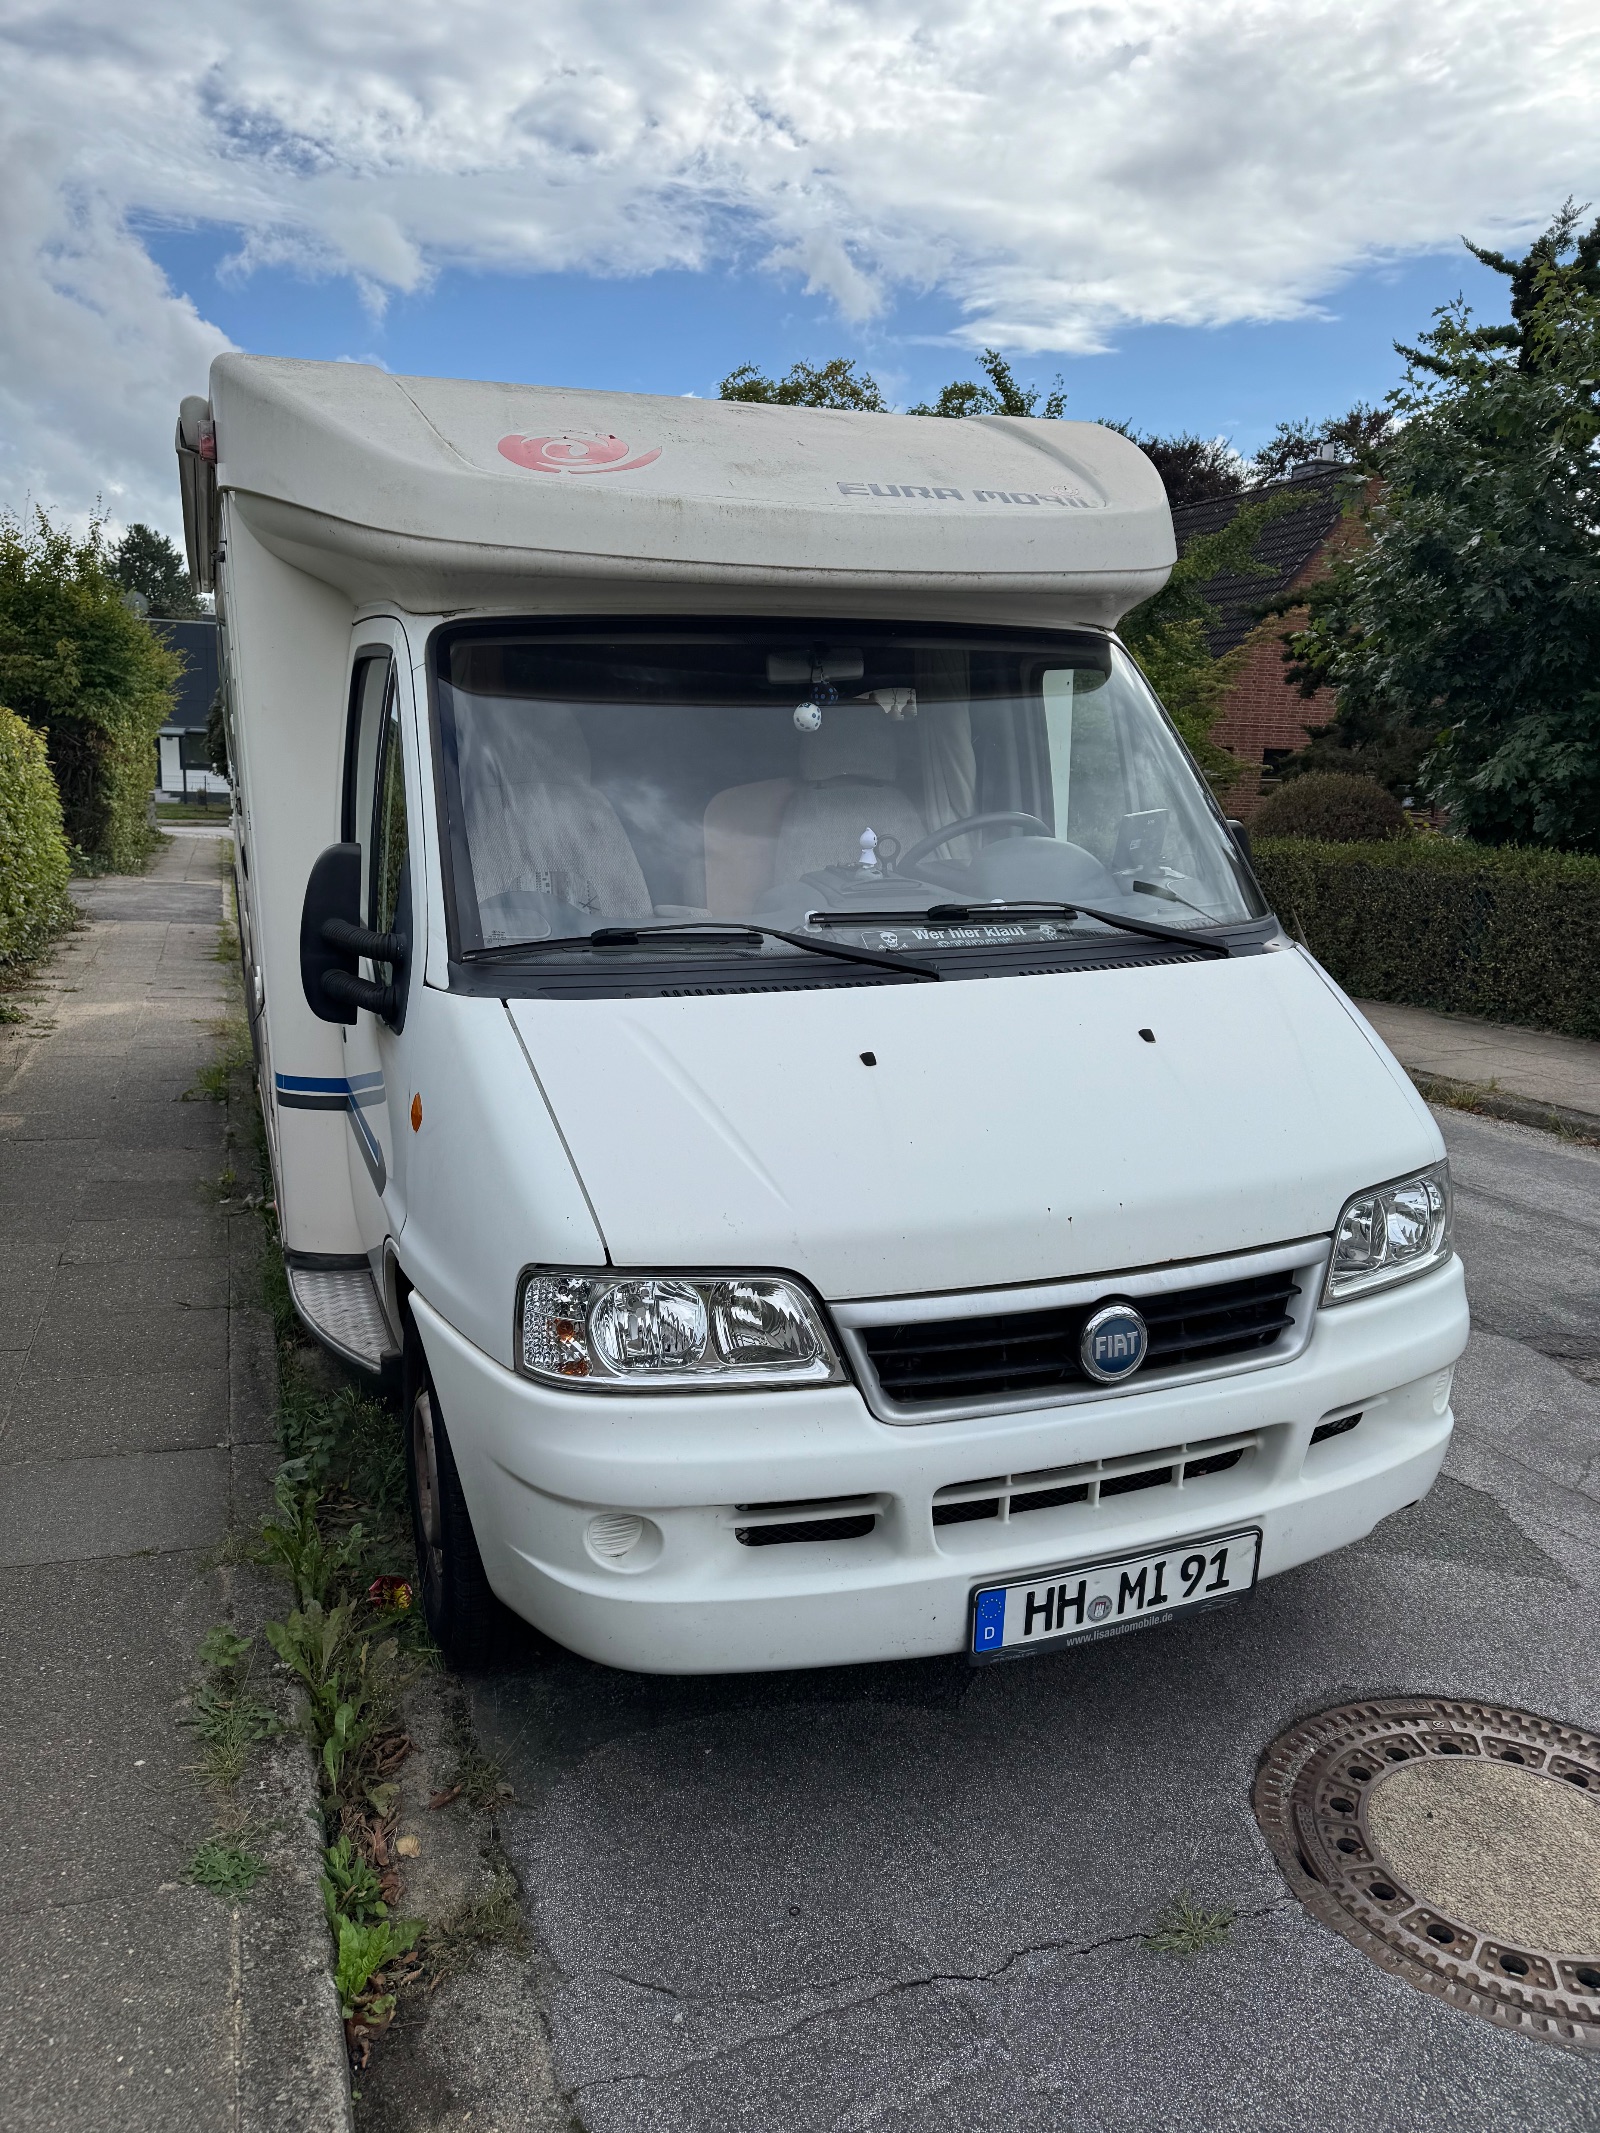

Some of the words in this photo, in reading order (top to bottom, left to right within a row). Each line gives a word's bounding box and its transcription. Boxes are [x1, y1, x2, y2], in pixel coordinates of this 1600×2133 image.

[837, 482, 964, 501] EURA
[912, 929, 945, 940] Wer
[948, 927, 981, 939] hier
[983, 925, 1027, 937] klaut
[1096, 1331, 1138, 1359] FIAT
[1024, 1580, 1087, 1636] HH
[1117, 1560, 1169, 1614] MI
[1180, 1547, 1231, 1598] 91
[984, 1627, 996, 1640] D
[1066, 1612, 1173, 1647] www.lisaautomobile.de
